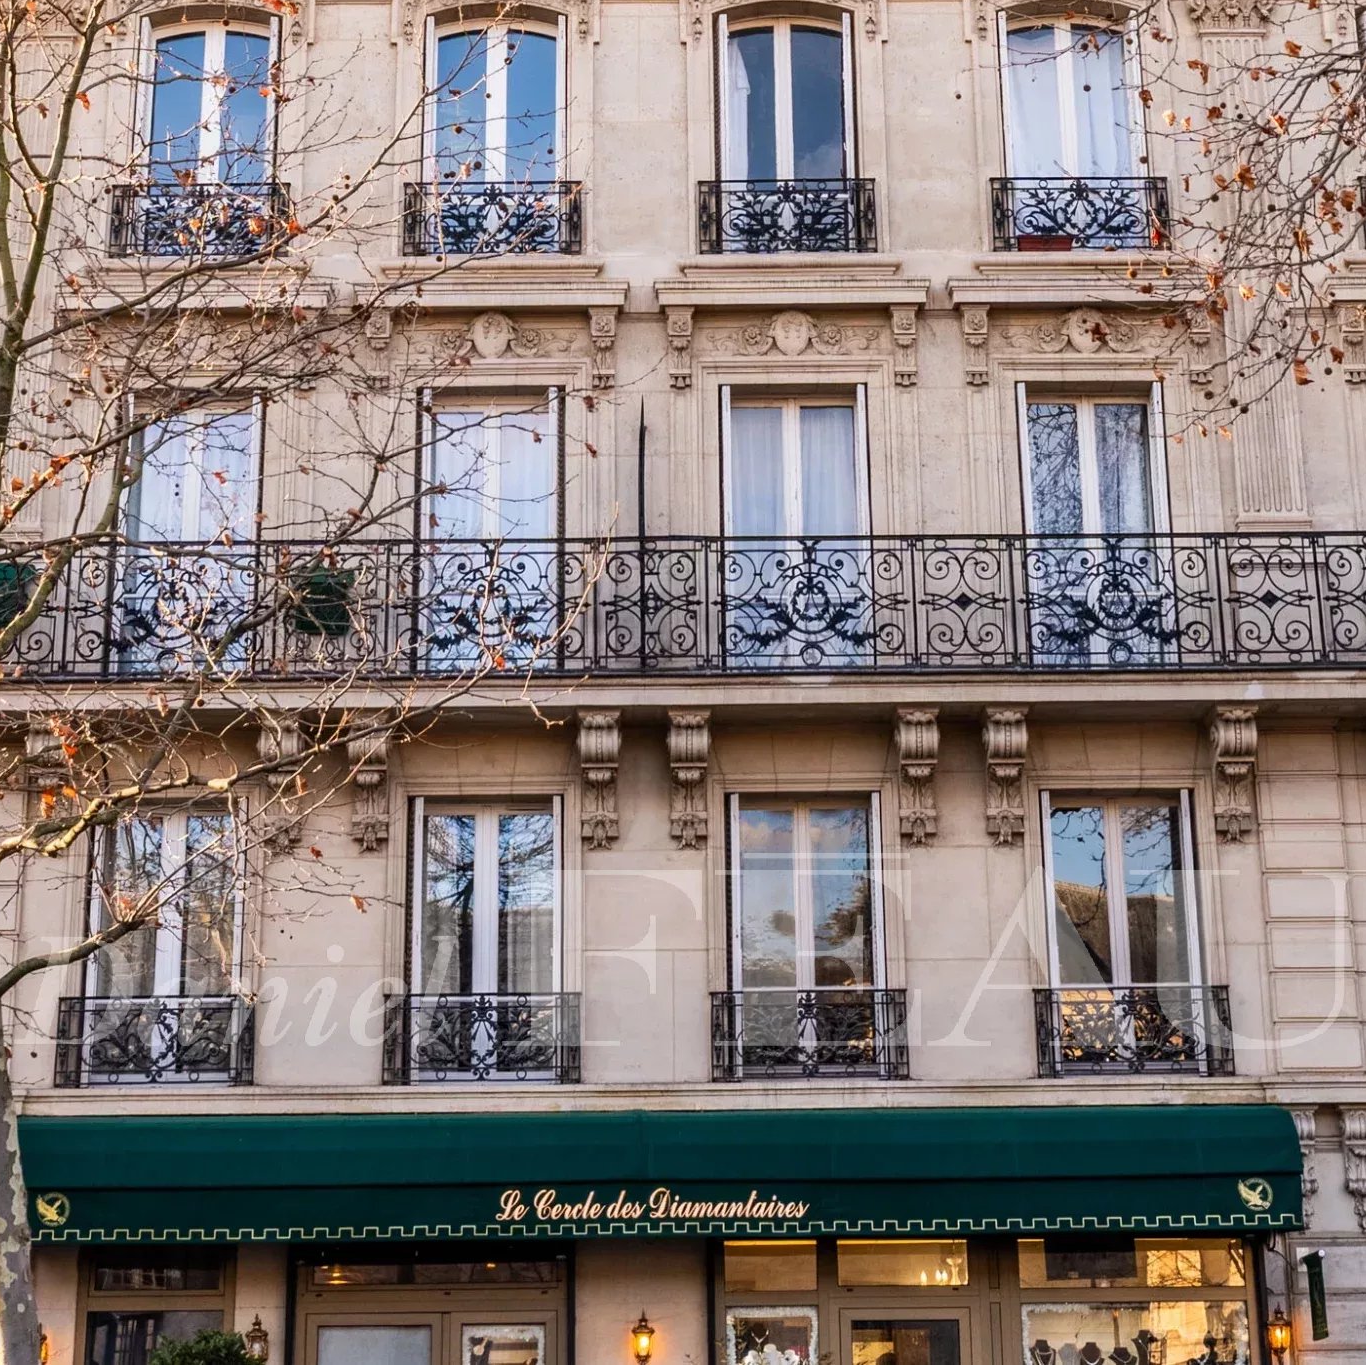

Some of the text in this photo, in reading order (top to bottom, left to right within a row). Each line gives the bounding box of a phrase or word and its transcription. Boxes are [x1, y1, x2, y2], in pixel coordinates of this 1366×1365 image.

[495, 1187, 810, 1221] Le Cercle des Diamantaires
